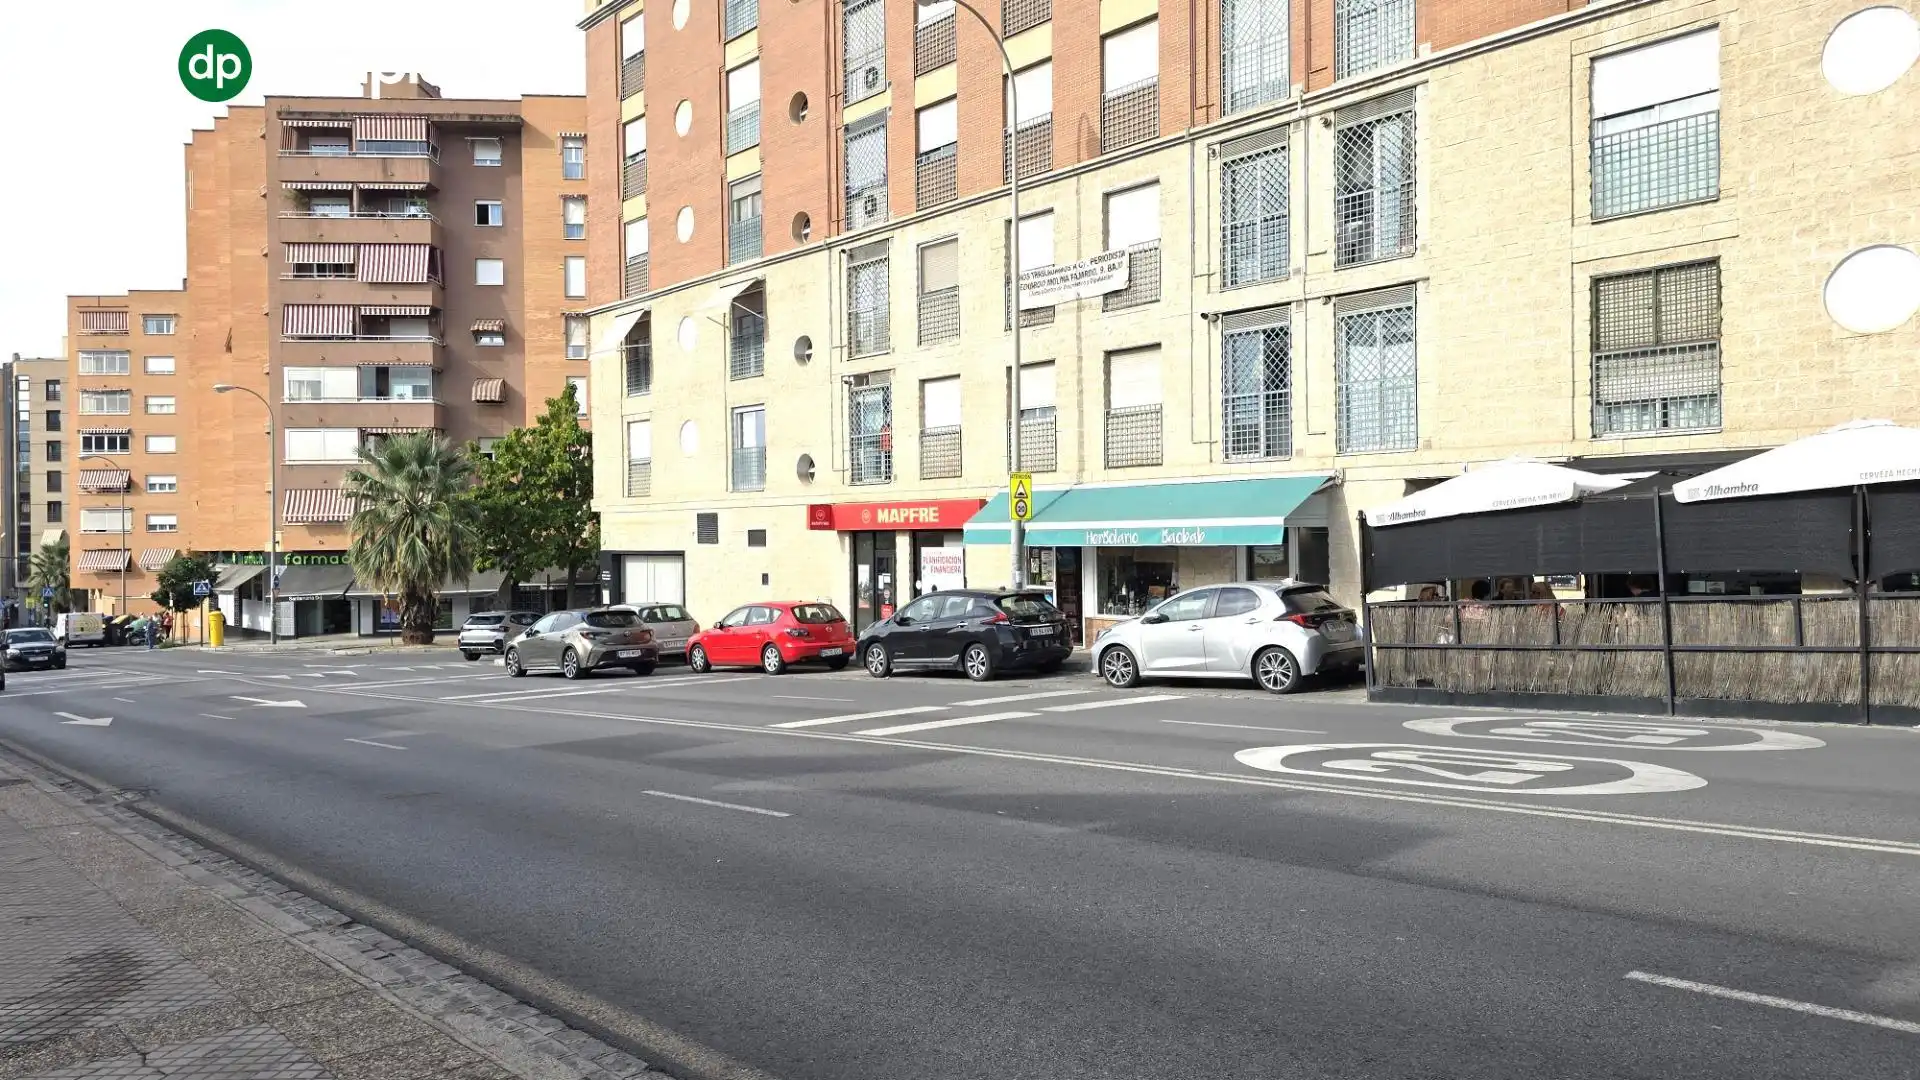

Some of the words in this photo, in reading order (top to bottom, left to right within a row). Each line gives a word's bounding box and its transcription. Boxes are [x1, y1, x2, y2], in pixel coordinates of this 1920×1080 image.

[1090, 250, 1126, 265] PERIODISTA
[1046, 275, 1070, 287] MOLINA
[1859, 469, 1894, 480] CERVEZA
[1704, 482, 1759, 497] Alhambra
[877, 507, 940, 523] MAPFRE
[1388, 509, 1427, 521] Alhambra
[1161, 526, 1206, 545] Baobab
[1321, 750, 1576, 785] 20
